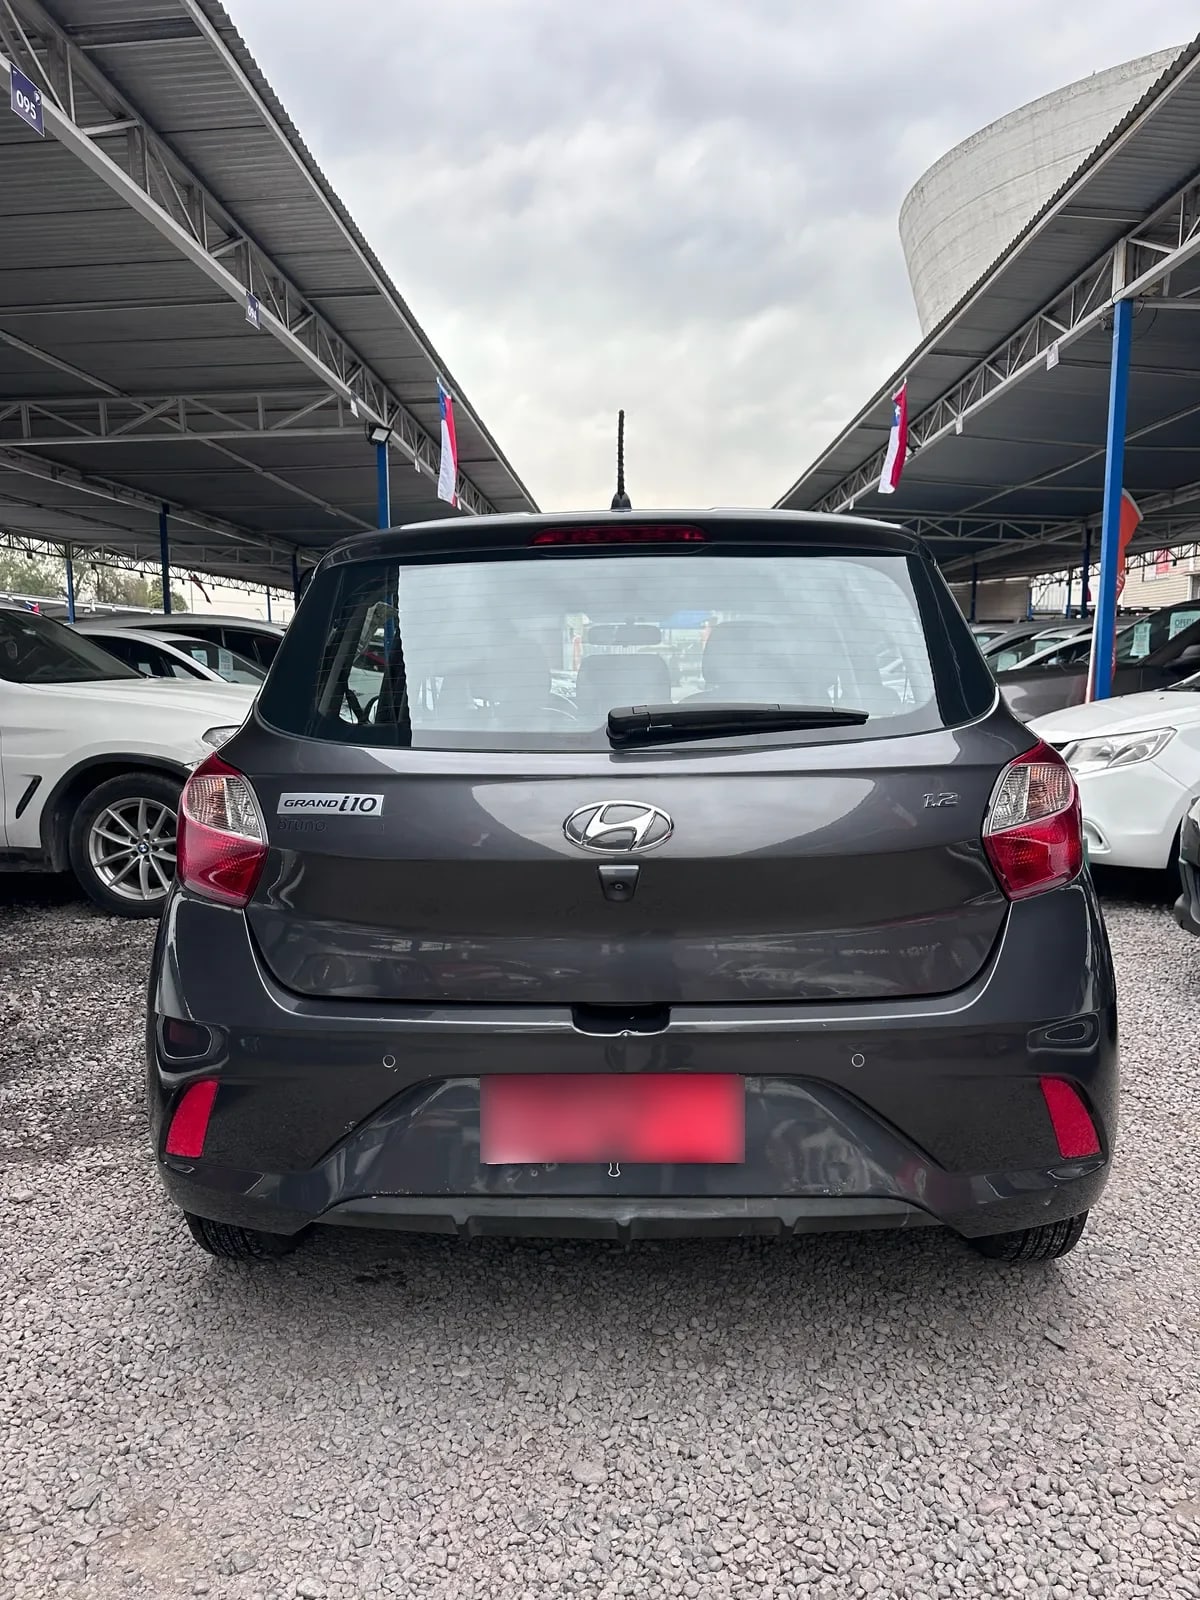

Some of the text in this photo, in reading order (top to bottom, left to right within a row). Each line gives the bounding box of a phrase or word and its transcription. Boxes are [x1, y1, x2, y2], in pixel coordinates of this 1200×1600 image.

[16, 89, 37, 120] 095
[283, 795, 377, 812] GRAND i10
[923, 792, 959, 808] 1.2
